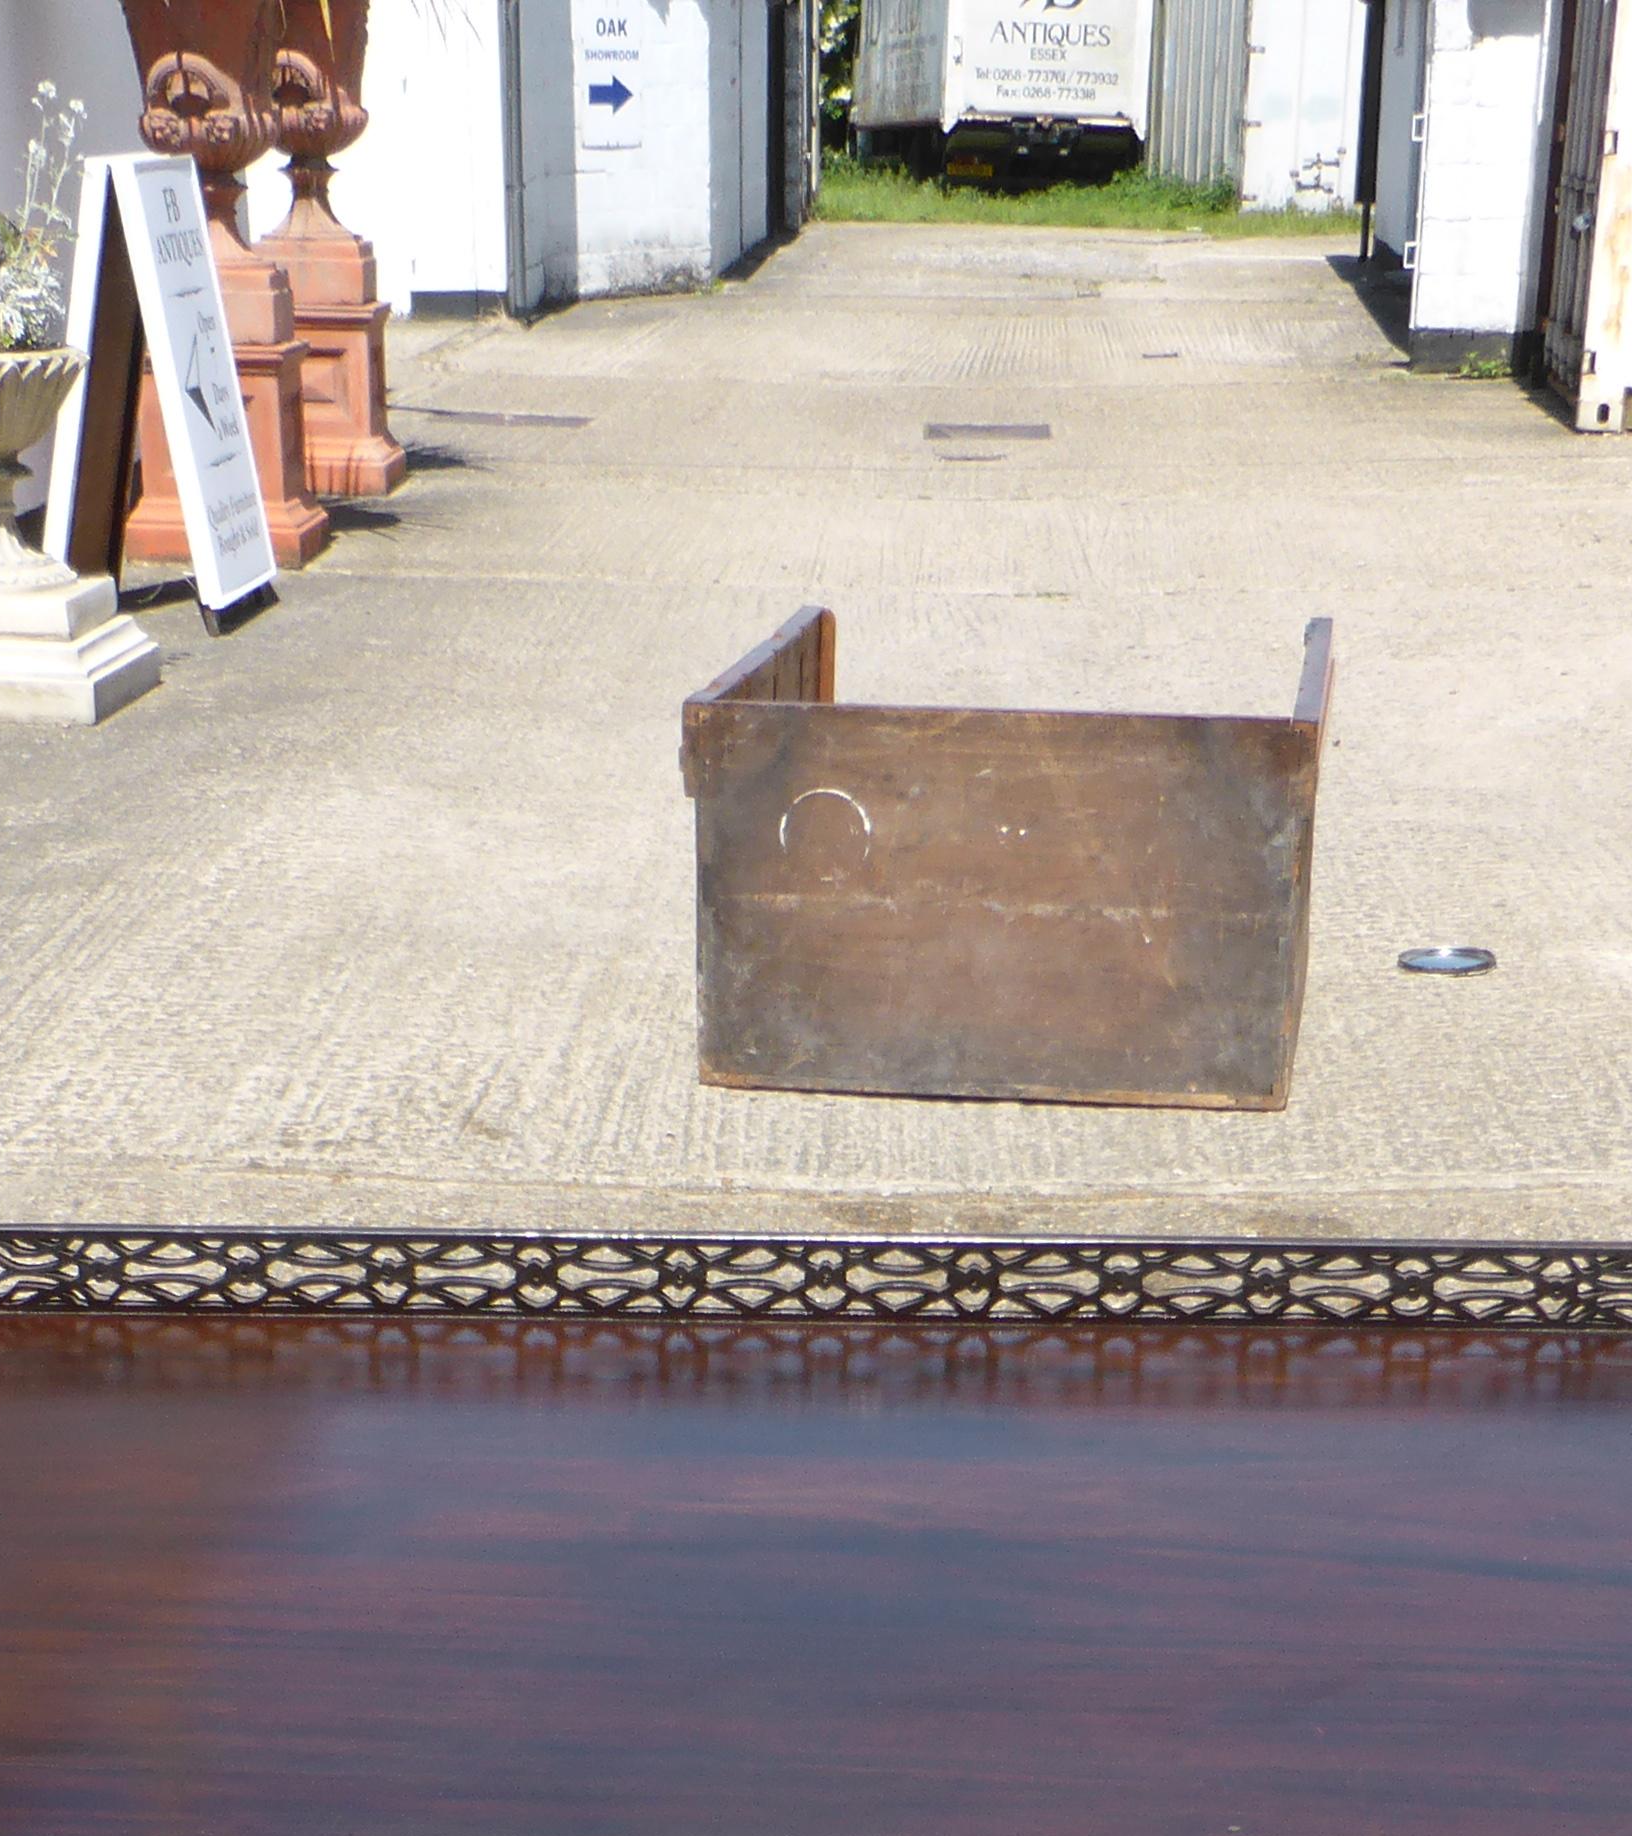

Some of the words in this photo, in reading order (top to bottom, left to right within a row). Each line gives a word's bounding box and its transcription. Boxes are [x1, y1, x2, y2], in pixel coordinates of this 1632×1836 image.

[596, 17, 628, 37] OAK
[990, 20, 1112, 48] ANTIQUES
[584, 49, 640, 61] SHOWROOM
[1029, 48, 1068, 61] ESSEX
[162, 187, 181, 223] FB
[156, 229, 205, 266] ANTIQUES
